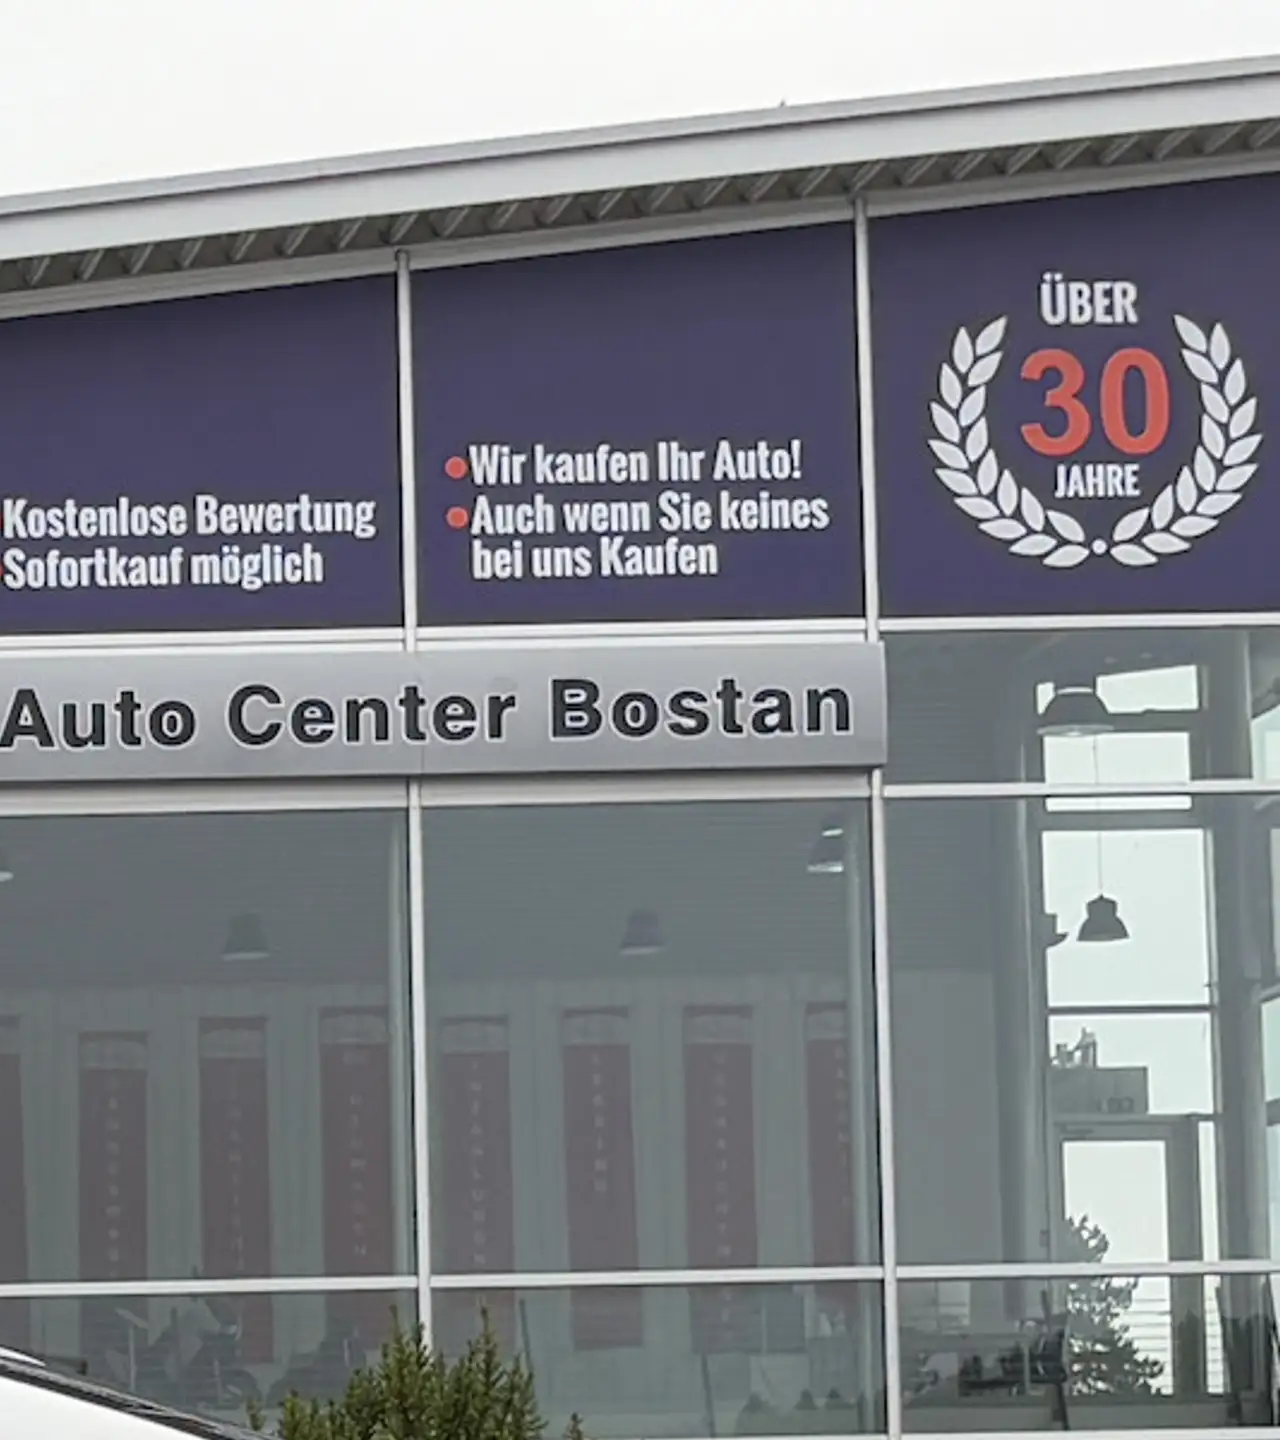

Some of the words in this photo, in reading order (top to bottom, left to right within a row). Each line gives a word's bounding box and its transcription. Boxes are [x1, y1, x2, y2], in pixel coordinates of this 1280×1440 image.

[1040, 272, 1139, 326] ÜBER
[1020, 348, 1172, 457] 30
[468, 443, 528, 486] Wir
[534, 442, 650, 484] kaufen
[657, 440, 707, 482] Ihr
[712, 438, 803, 481] Auto!
[1054, 462, 1142, 499] JAHRE
[2, 496, 188, 540] Kostenlose
[195, 493, 378, 542] Bewertung
[470, 492, 556, 536] Auch
[562, 500, 651, 534] wenn
[658, 489, 714, 532] Sie
[719, 488, 831, 531] keines
[2, 545, 184, 589] Sofortkauf
[190, 542, 325, 592] möglich
[471, 538, 521, 580] bei
[531, 546, 593, 579] uns
[599, 535, 719, 578] Kaufen
[226, 683, 518, 748] Center
[550, 677, 852, 740] Bostan
